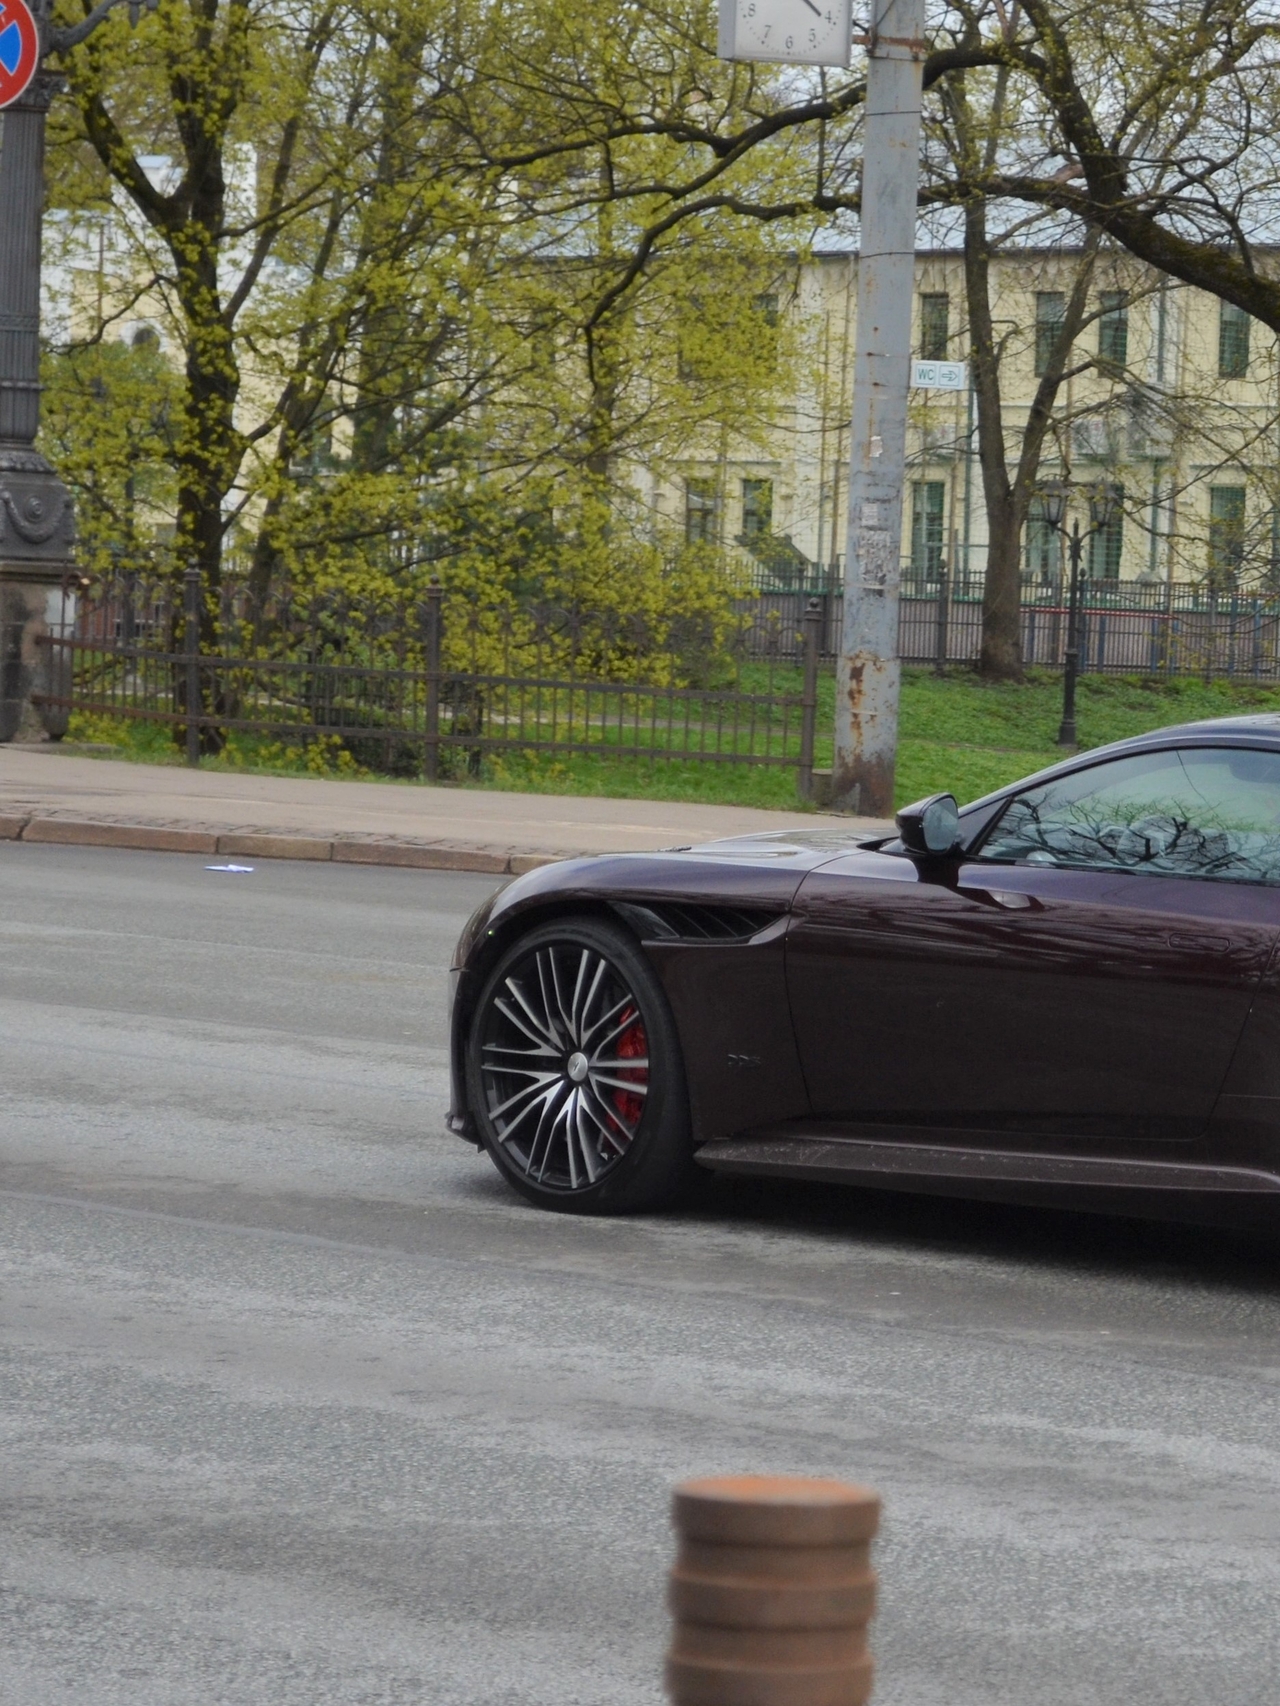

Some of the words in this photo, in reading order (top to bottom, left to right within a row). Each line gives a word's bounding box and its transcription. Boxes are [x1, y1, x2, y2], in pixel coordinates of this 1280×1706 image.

[747, 3, 756, 17] 8
[824, 10, 832, 24] 4
[764, 24, 772, 39] 7
[808, 28, 816, 42] 5
[785, 35, 793, 49] 6
[917, 368, 934, 381] WC
